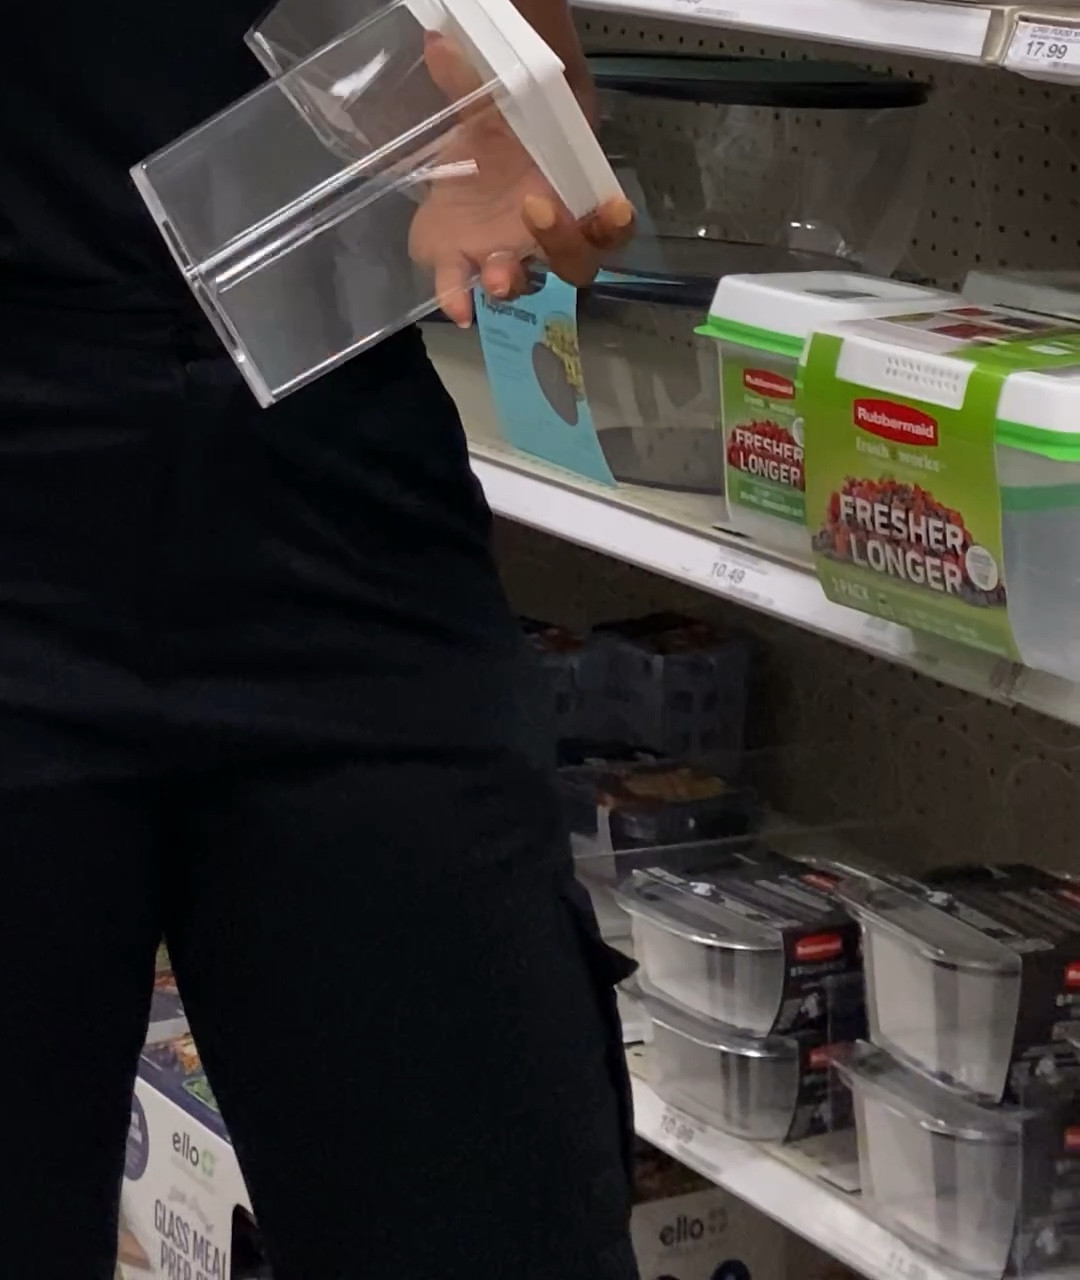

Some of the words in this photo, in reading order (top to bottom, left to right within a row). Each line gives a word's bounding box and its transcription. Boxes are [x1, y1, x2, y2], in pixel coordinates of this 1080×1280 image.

[1027, 41, 1068, 59] 17.99
[857, 406, 934, 439] Rubbermaid
[735, 428, 804, 465] FRESHER
[739, 450, 801, 491] LONGER
[839, 492, 965, 557] FRESHER
[711, 561, 746, 585] 10.49
[850, 533, 962, 595] LONGER
[172, 1131, 200, 1167] ello
[154, 1198, 190, 1255] GLASS
[659, 1215, 705, 1247] ello
